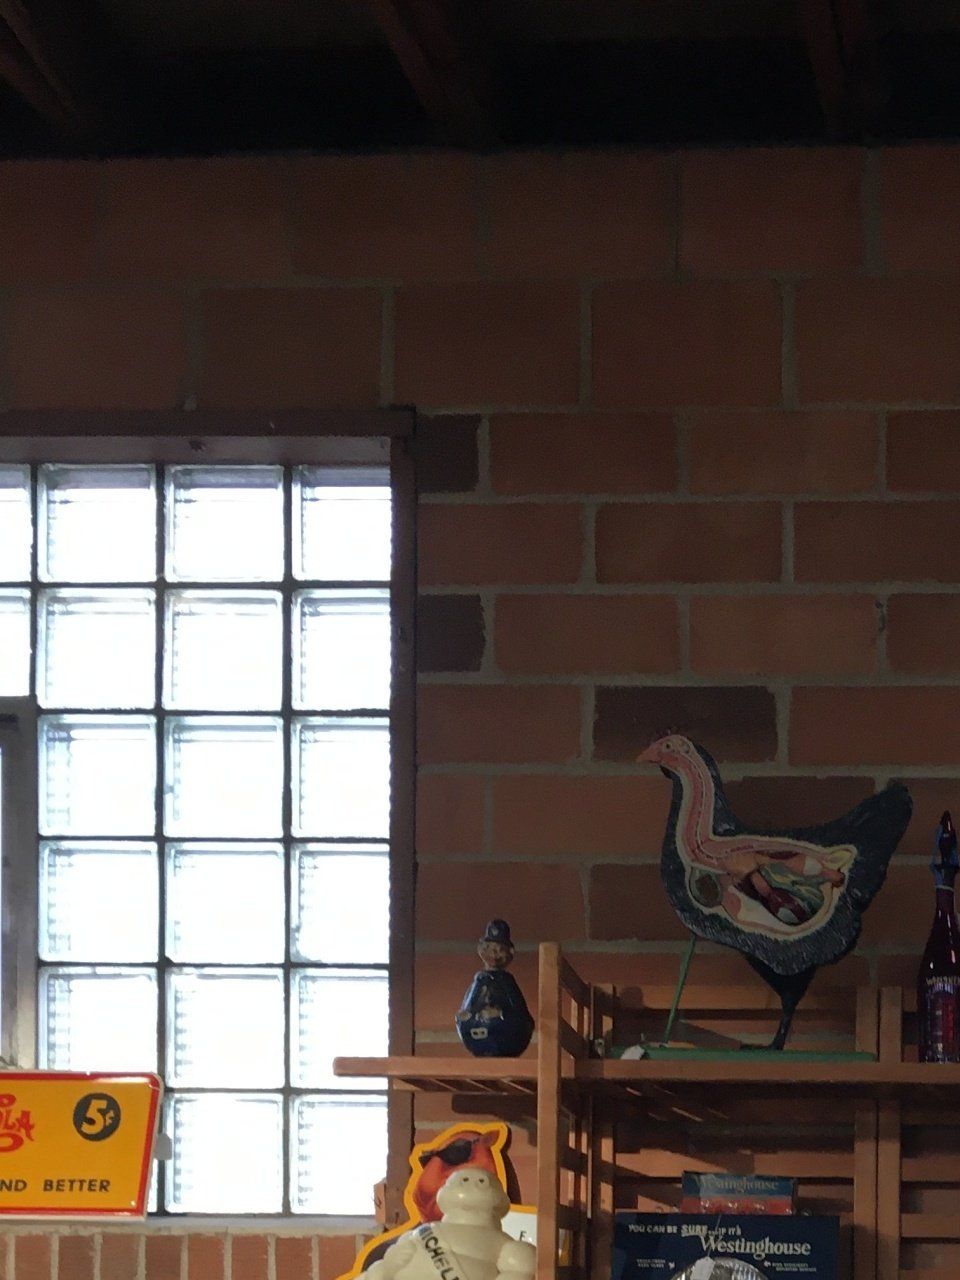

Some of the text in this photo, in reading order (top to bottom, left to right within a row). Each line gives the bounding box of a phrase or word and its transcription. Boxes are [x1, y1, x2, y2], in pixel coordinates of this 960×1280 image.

[43, 1178, 111, 1193] BETTER
[693, 1173, 779, 1194] Westinghouse
[628, 1224, 645, 1233] YOU
[647, 1224, 665, 1234] CAN
[667, 1224, 678, 1234] BE
[700, 1235, 812, 1260] Westinghouse
